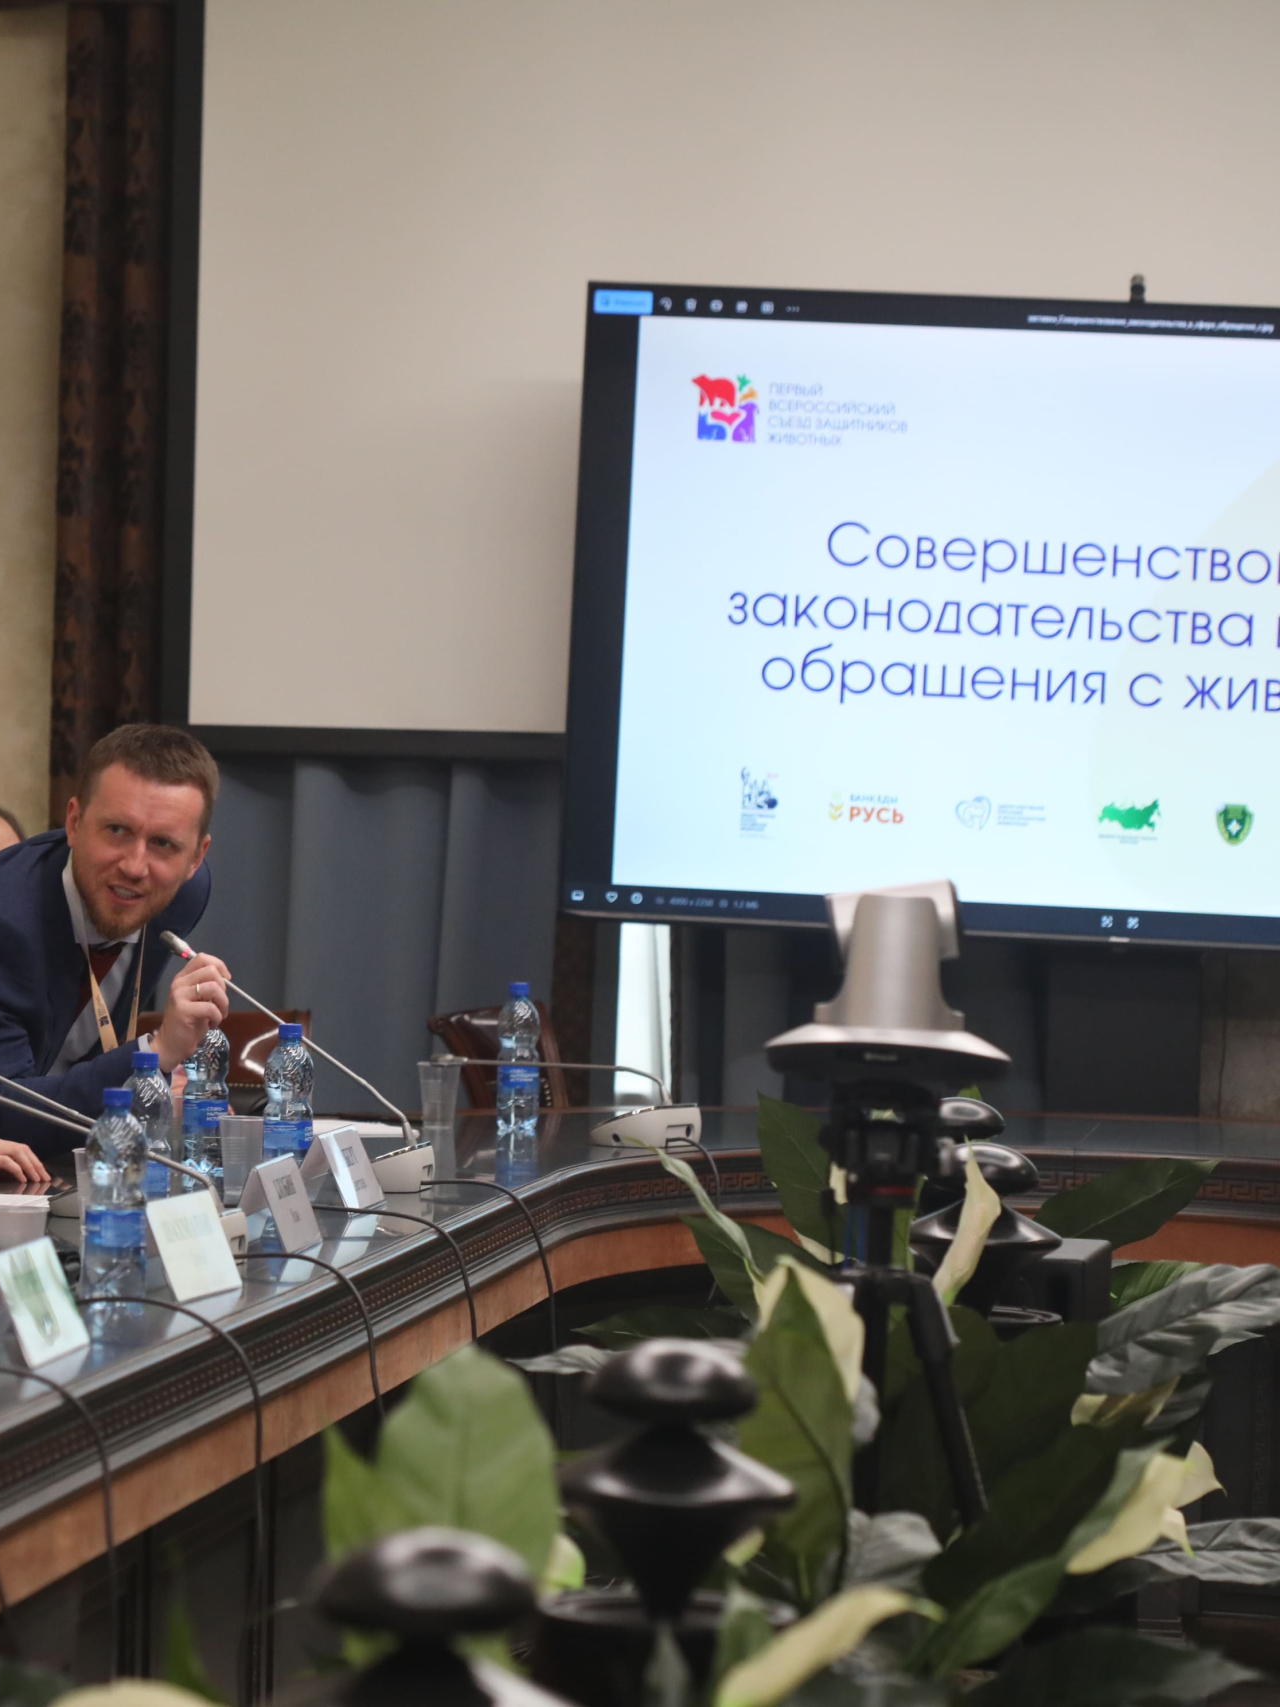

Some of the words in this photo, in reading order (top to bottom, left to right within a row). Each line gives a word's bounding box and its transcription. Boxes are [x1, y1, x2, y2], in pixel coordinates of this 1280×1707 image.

[769, 382, 823, 396] ПЕРВЫЙ
[769, 399, 896, 415] ВСЕРОССИЙСКИЙ
[768, 432, 842, 446] ЖИВОТНЫХ
[827, 521, 1280, 585] Совершенство
[728, 591, 1254, 648] законодательства
[761, 643, 1107, 705] обращения
[1129, 673, 1163, 707] с
[849, 806, 905, 824] РУСЬ
